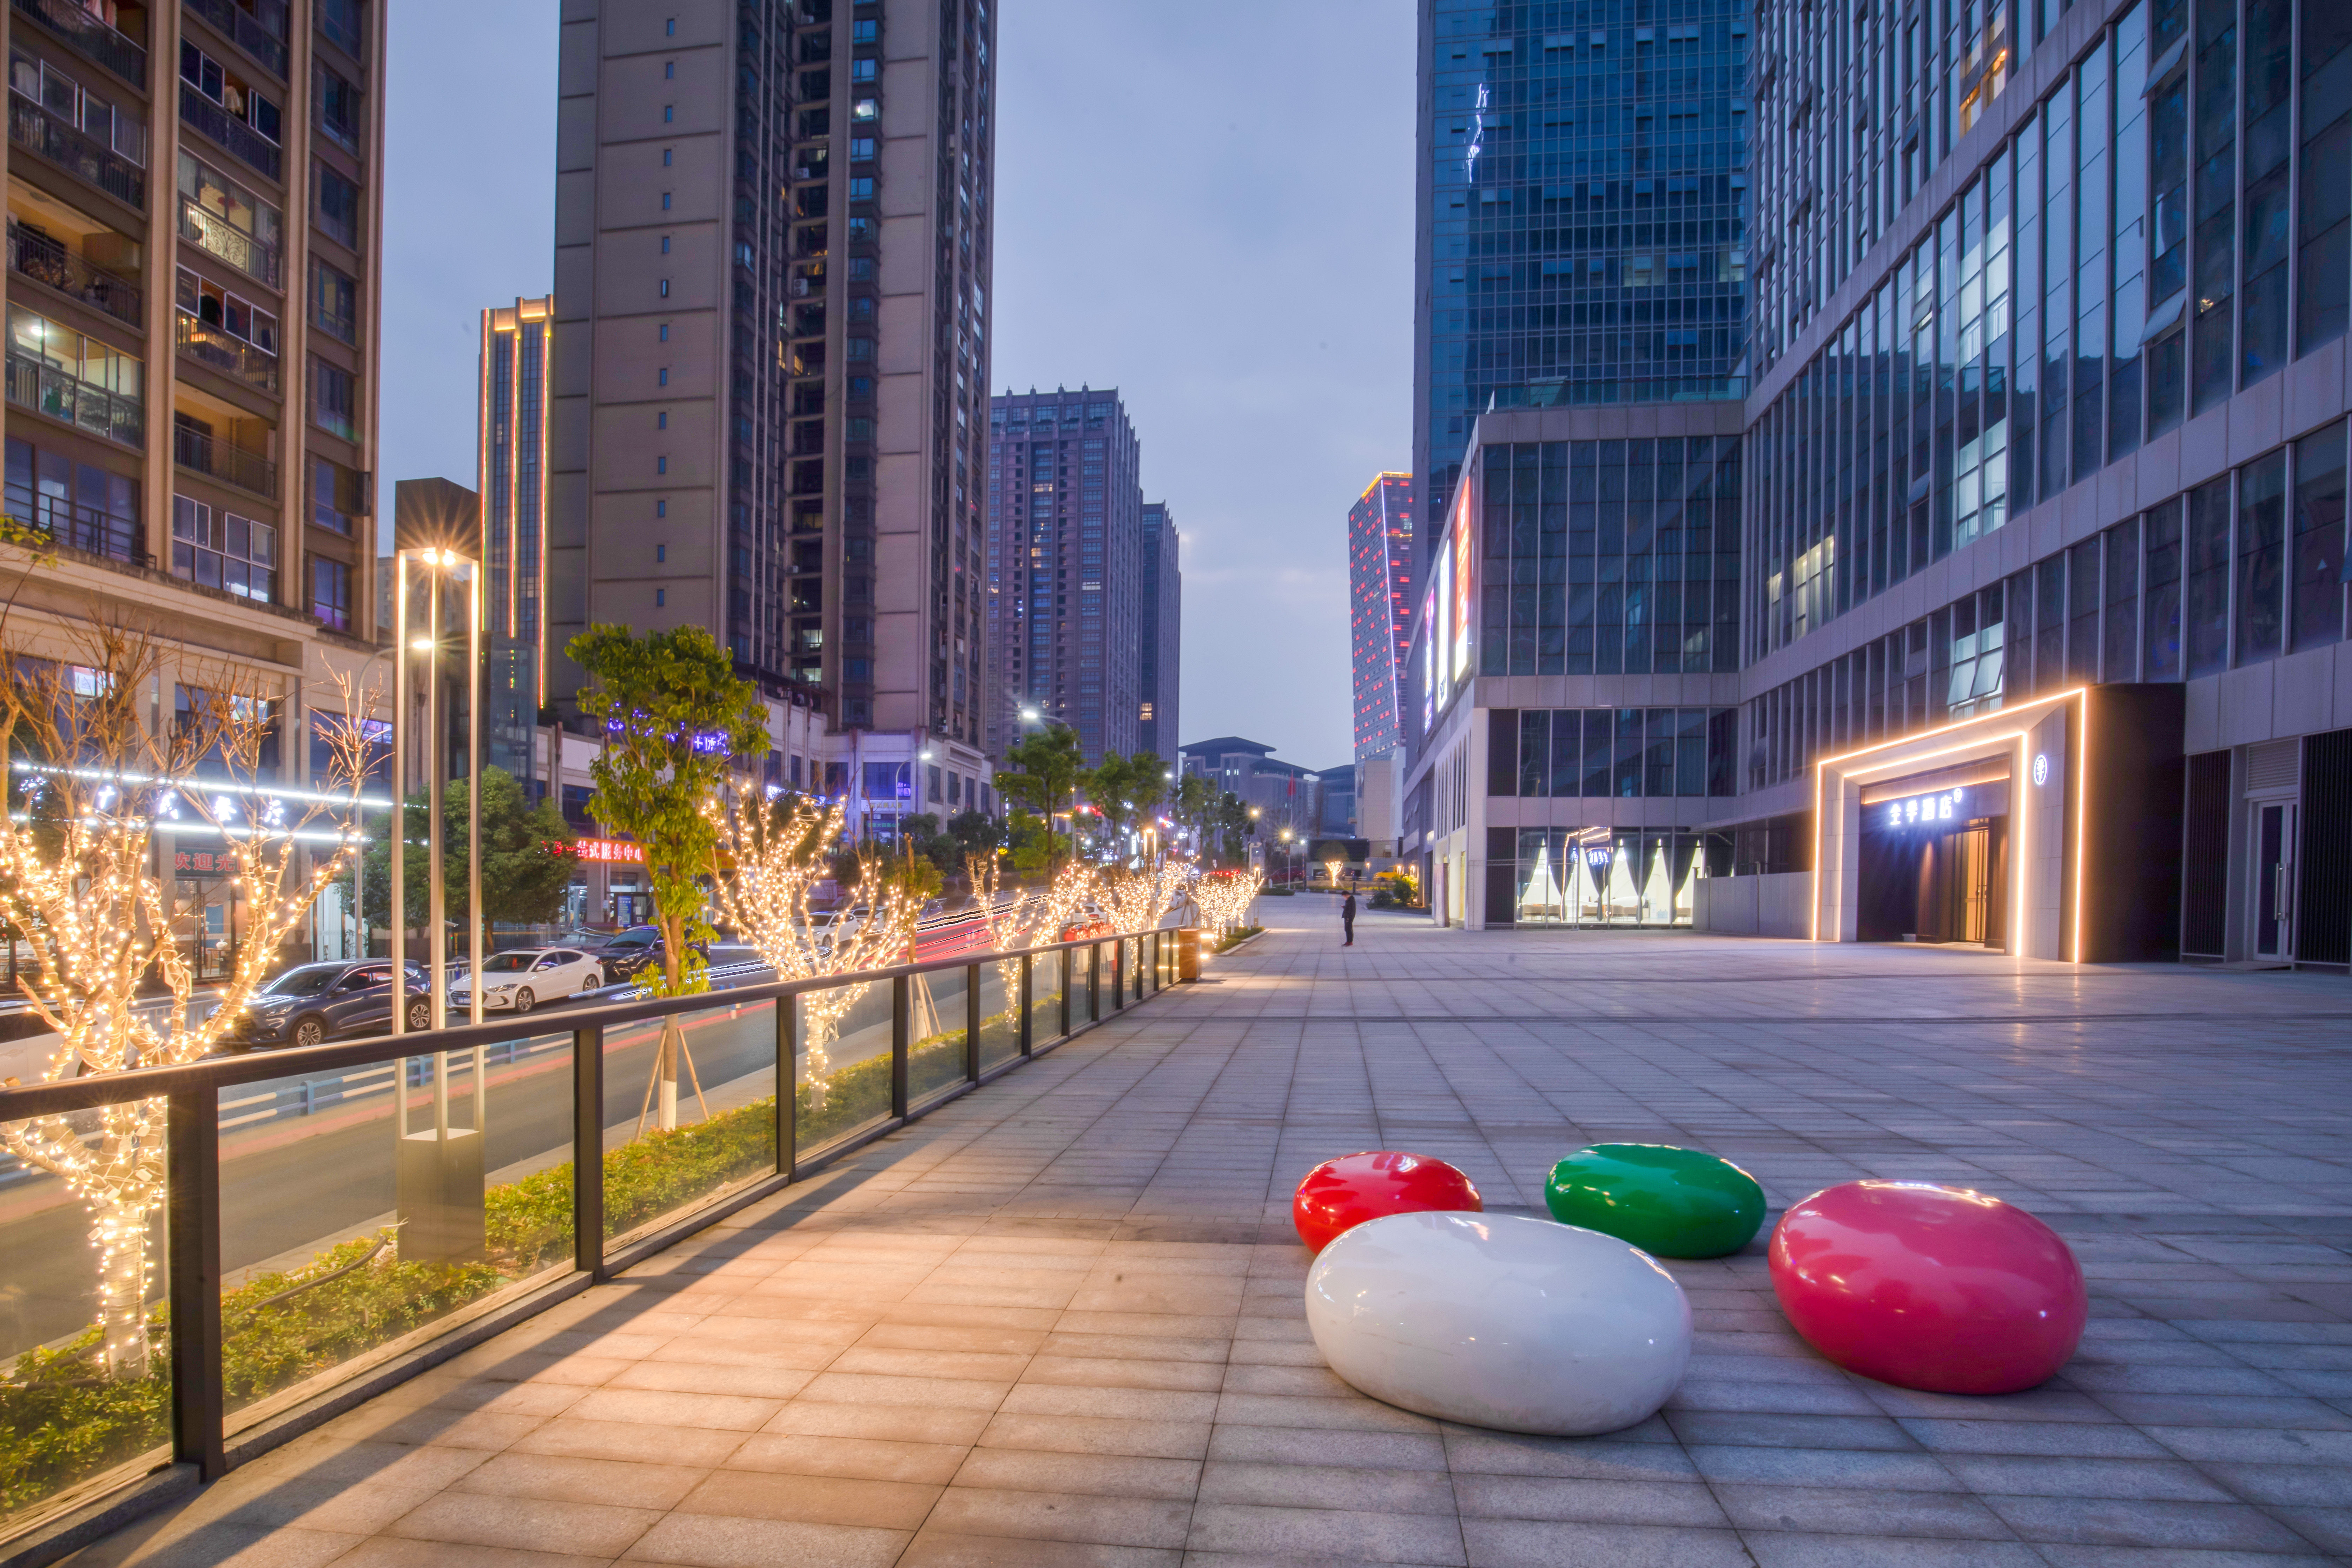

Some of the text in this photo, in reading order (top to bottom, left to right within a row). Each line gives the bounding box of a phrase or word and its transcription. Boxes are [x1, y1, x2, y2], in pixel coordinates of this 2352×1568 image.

[1890, 795, 1952, 825] 全季酒店
[175, 852, 241, 872] 欢迎光
